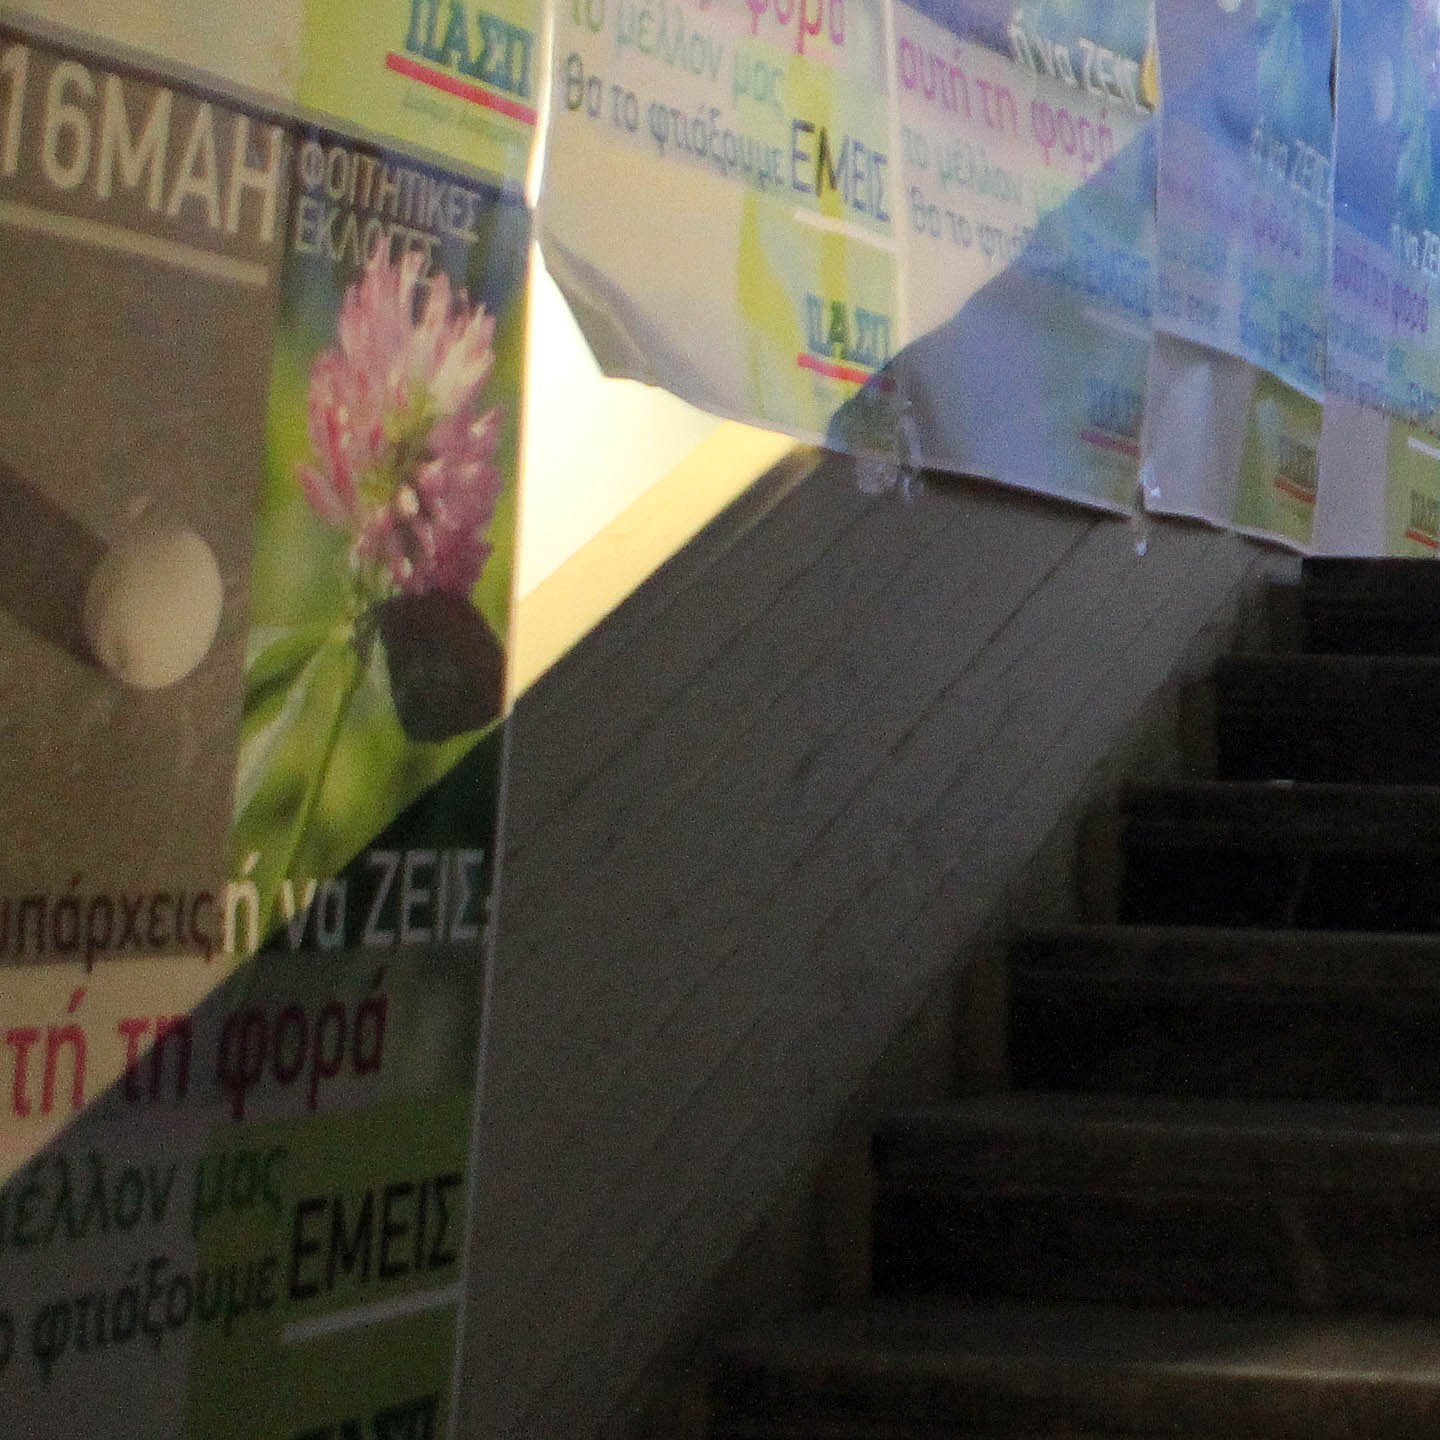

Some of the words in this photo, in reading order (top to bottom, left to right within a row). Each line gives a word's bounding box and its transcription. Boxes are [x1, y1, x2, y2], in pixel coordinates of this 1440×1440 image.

[0, 42, 285, 244] 16ΜΑΗ
[298, 140, 484, 242] ΦΟΙΤΗΤΙΚΕΣ
[565, 51, 602, 118] θα
[612, 85, 640, 133] το
[792, 118, 891, 223] ΕΜΕΙΣ
[224, 852, 260, 954] ή
[280, 879, 347, 951] να
[118, 1014, 192, 1104] τη
[216, 965, 389, 1120] φορά
[288, 1174, 463, 1298] ΕΜΕΙΣ
